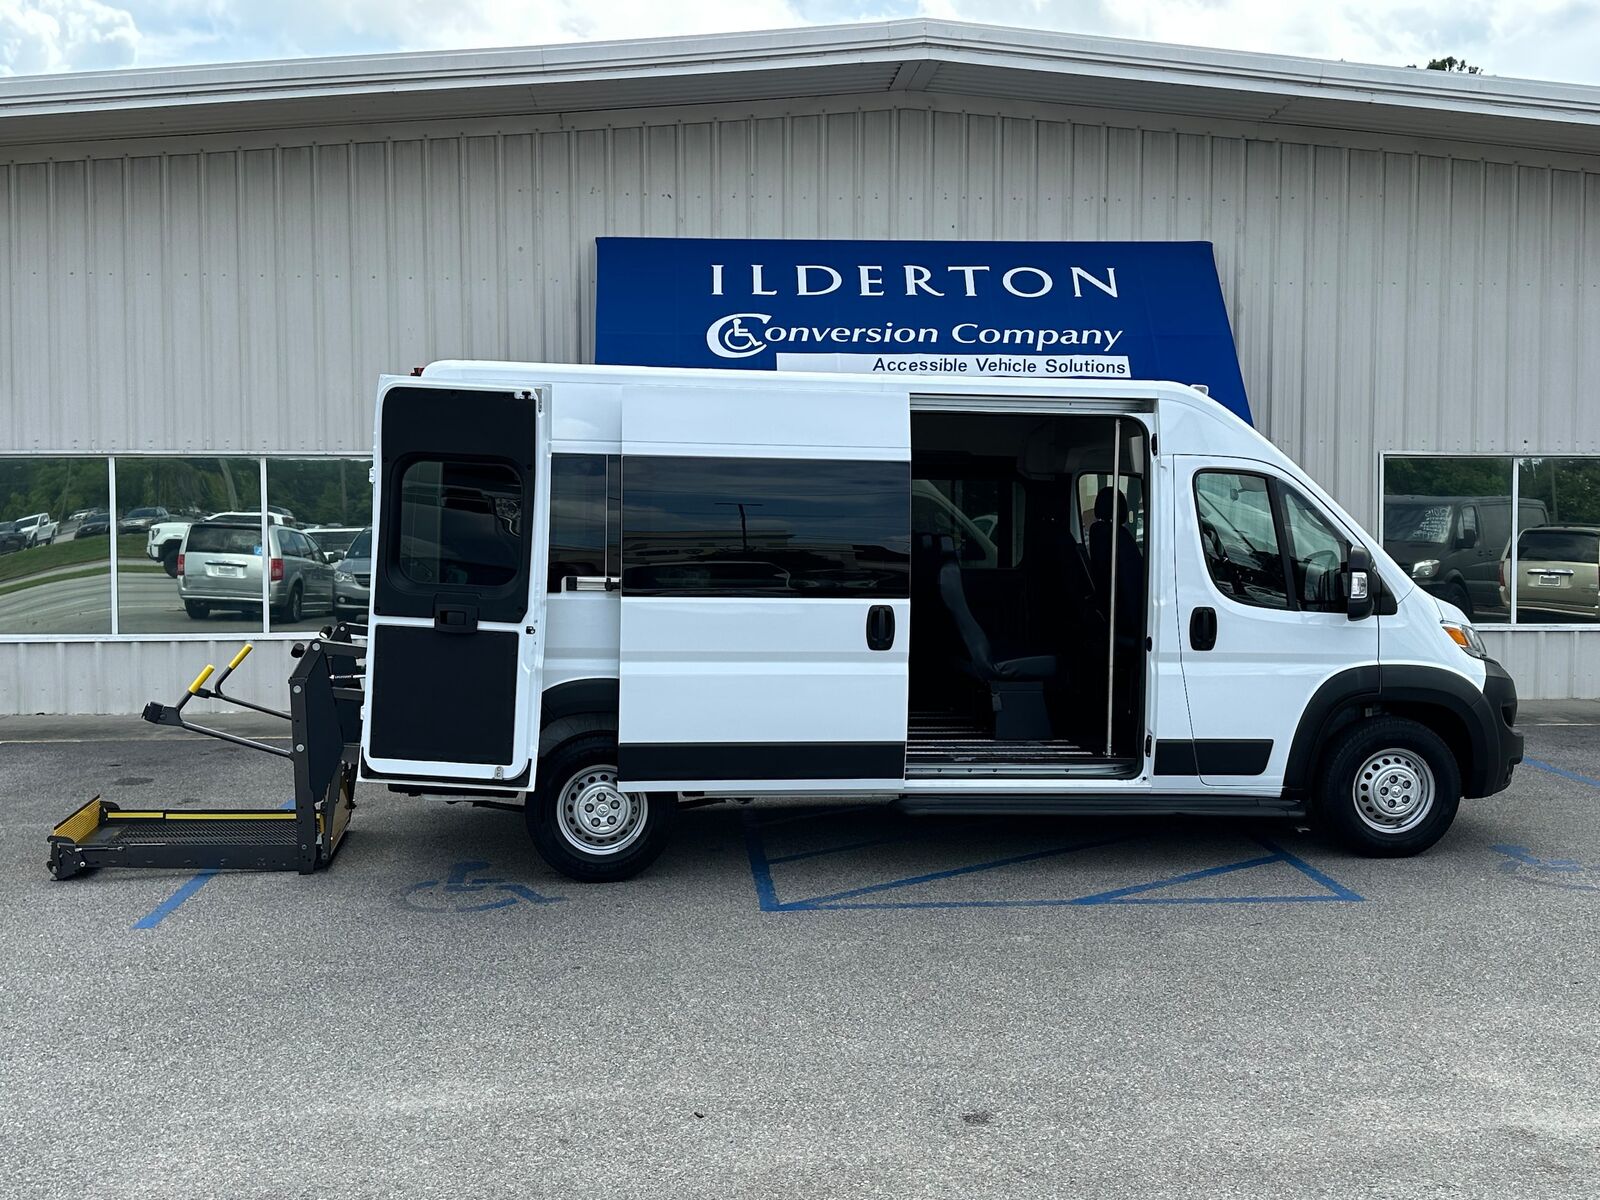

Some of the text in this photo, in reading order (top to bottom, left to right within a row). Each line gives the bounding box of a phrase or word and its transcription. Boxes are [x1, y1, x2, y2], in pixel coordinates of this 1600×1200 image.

[711, 264, 1119, 298] ILDERTON
[706, 313, 1123, 358] Conversion Company
[872, 358, 1126, 374] Accessible Vehicle Solutions
